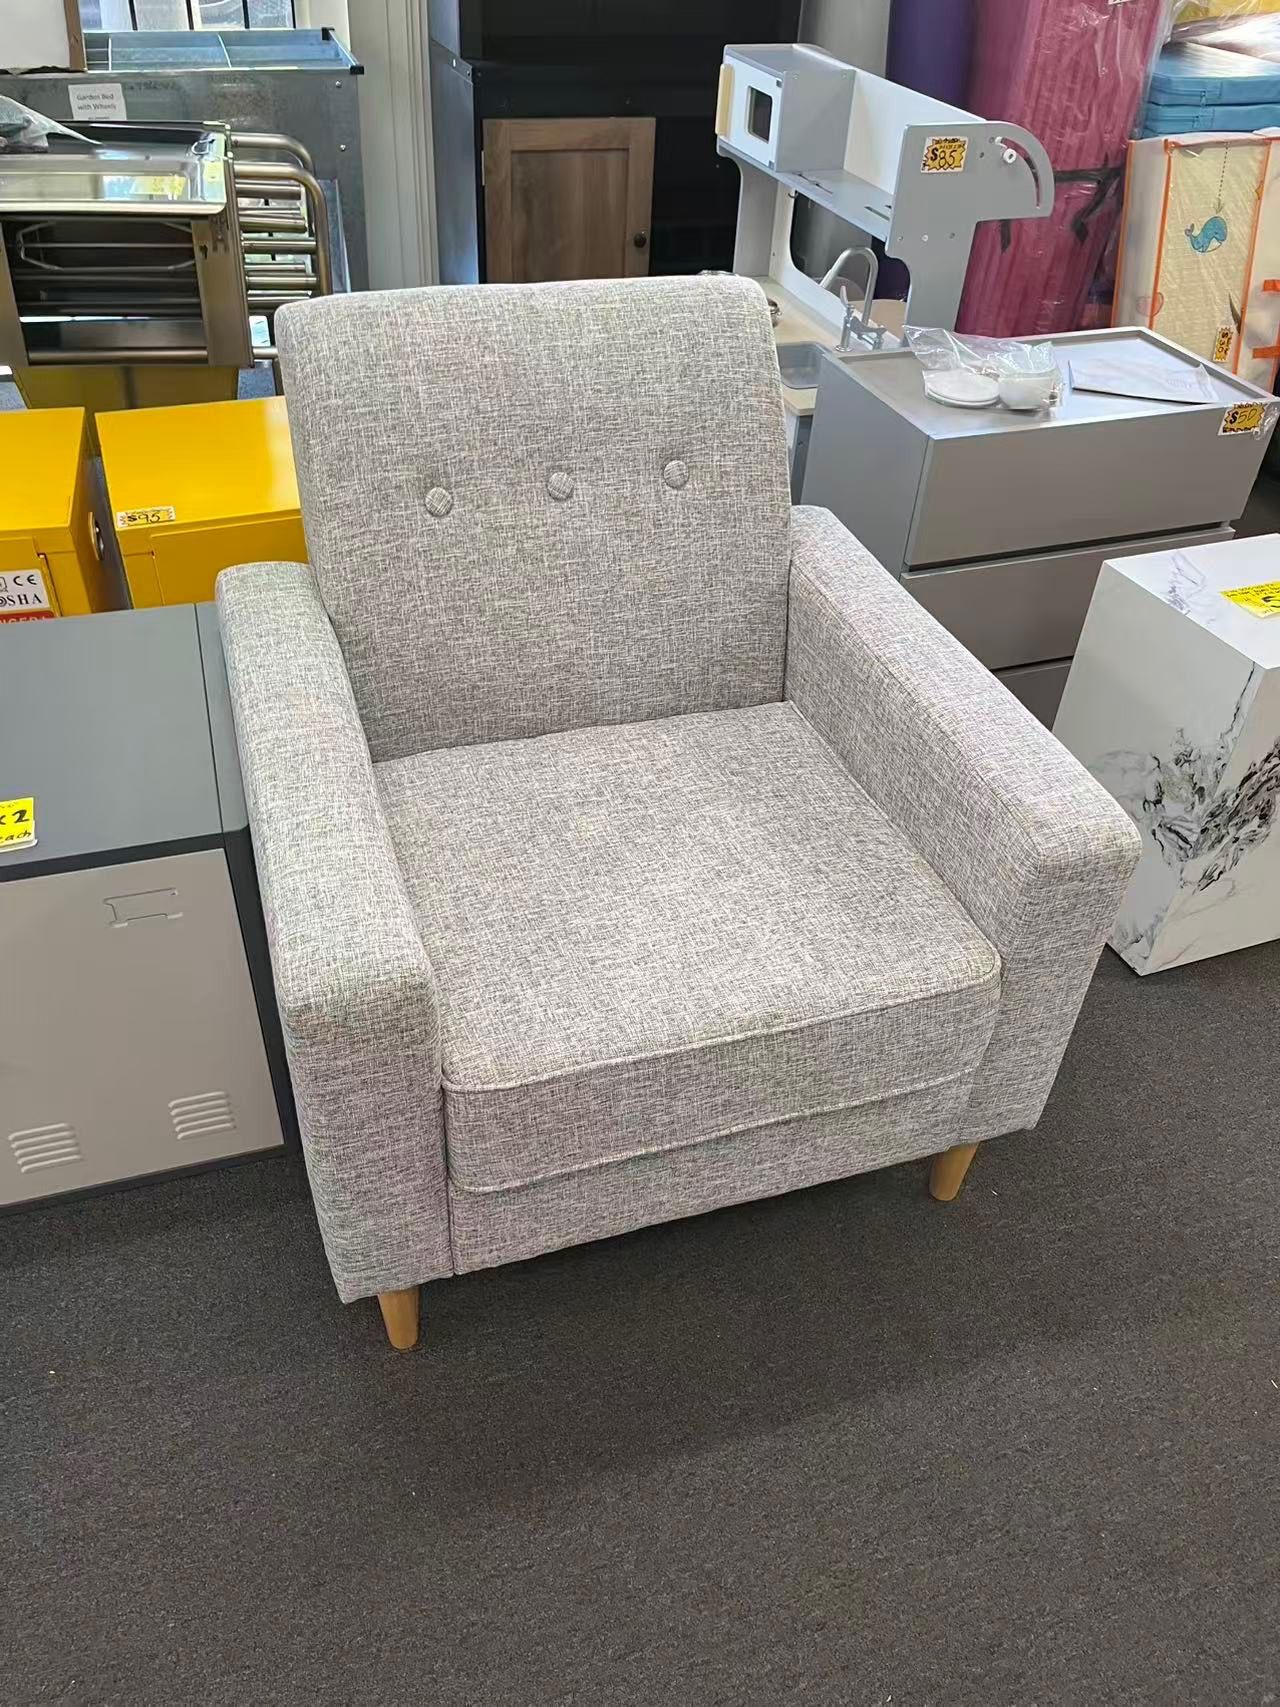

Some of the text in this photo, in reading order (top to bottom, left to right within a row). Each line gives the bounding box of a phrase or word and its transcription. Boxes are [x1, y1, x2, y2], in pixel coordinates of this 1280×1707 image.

[930, 147, 958, 168] $85
[1229, 408, 1258, 424] $50
[127, 510, 161, 523] $95
